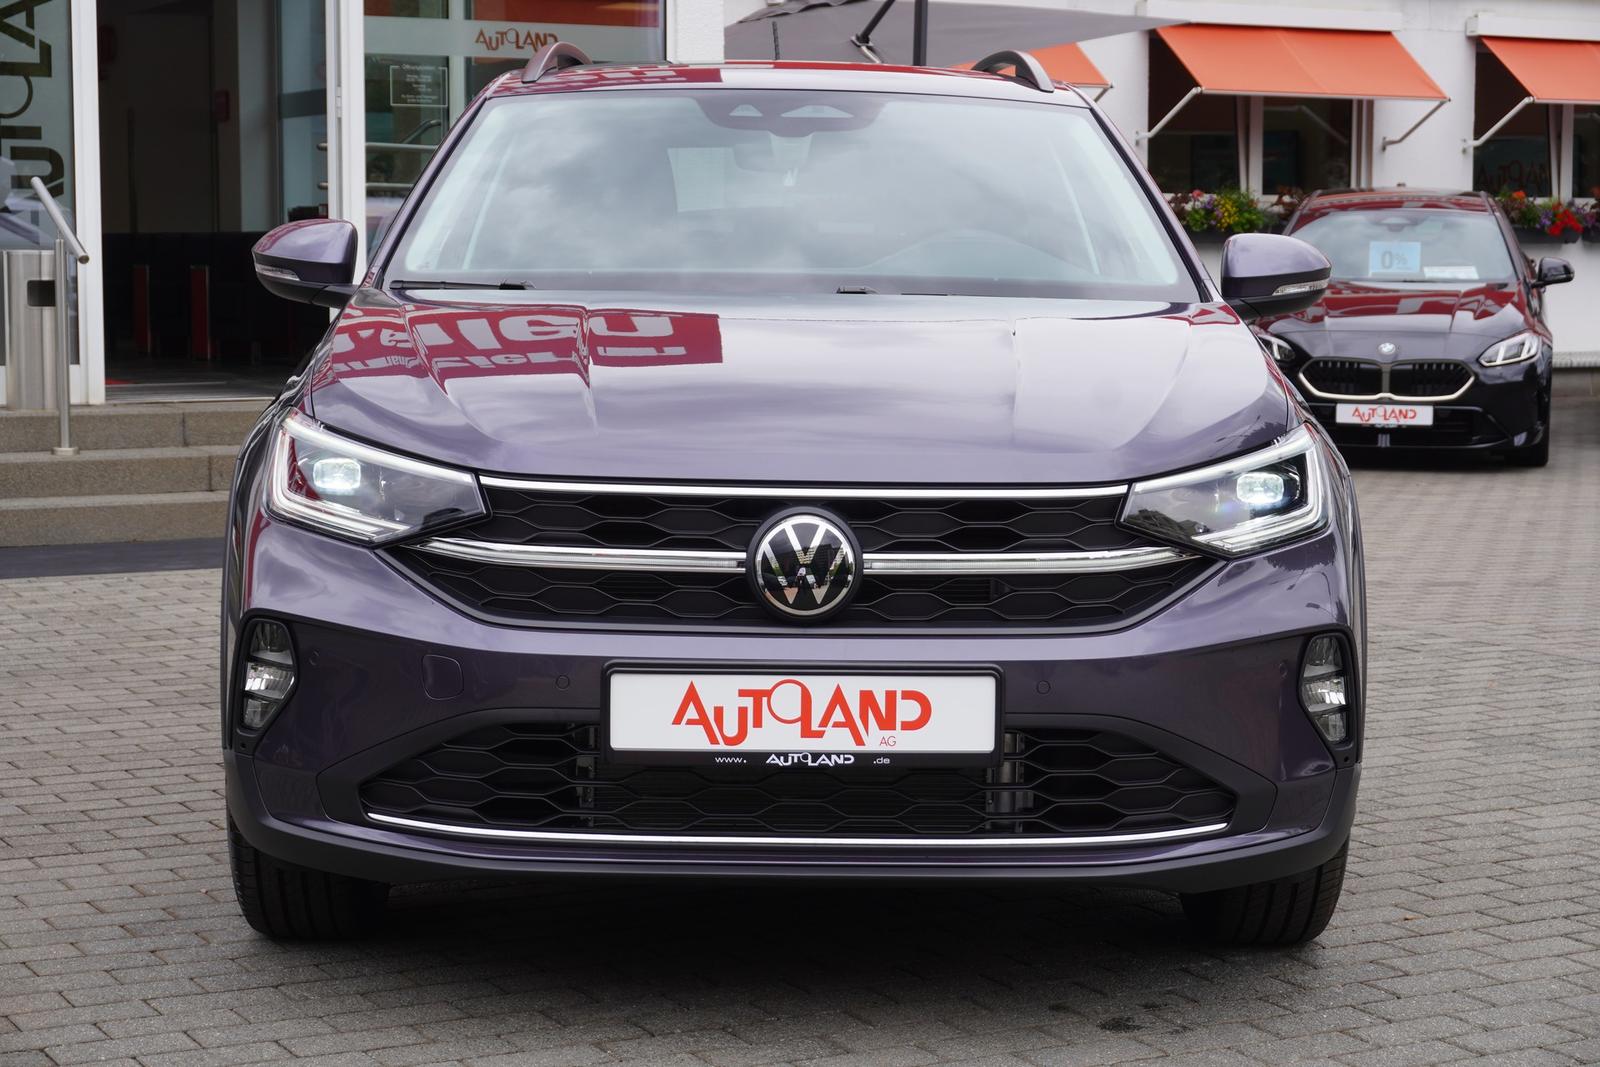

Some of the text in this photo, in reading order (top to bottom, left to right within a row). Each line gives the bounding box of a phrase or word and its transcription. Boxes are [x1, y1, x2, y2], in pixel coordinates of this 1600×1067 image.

[1351, 405, 1417, 423] AUTOLAND
[671, 678, 932, 747] AUTOLAND
[879, 735, 897, 747] AG
[714, 751, 891, 767] www. AUTOLAND .de
